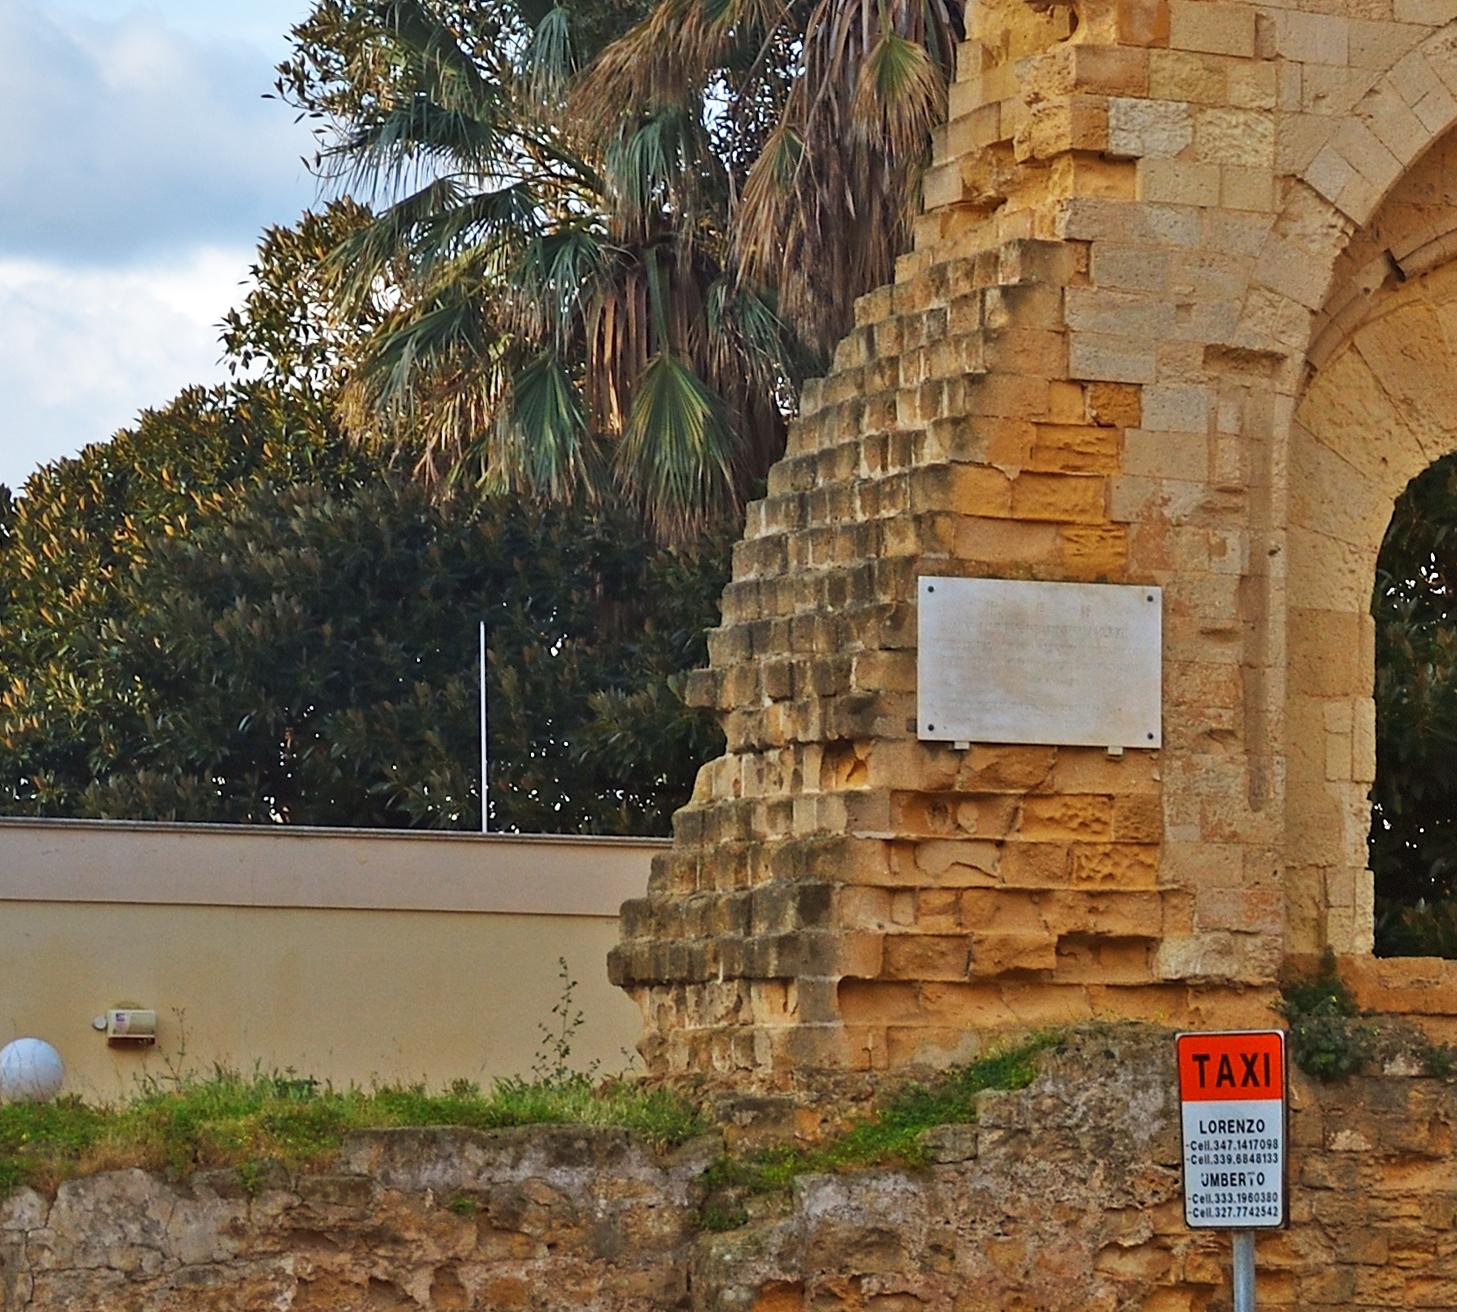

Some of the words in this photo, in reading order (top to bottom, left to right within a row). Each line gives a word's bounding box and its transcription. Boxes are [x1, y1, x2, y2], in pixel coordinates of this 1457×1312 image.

[1192, 1052, 1270, 1088] TAXI
[1199, 1118, 1265, 1134] LORENZO
[1201, 1172, 1265, 1187] UMBERTO
